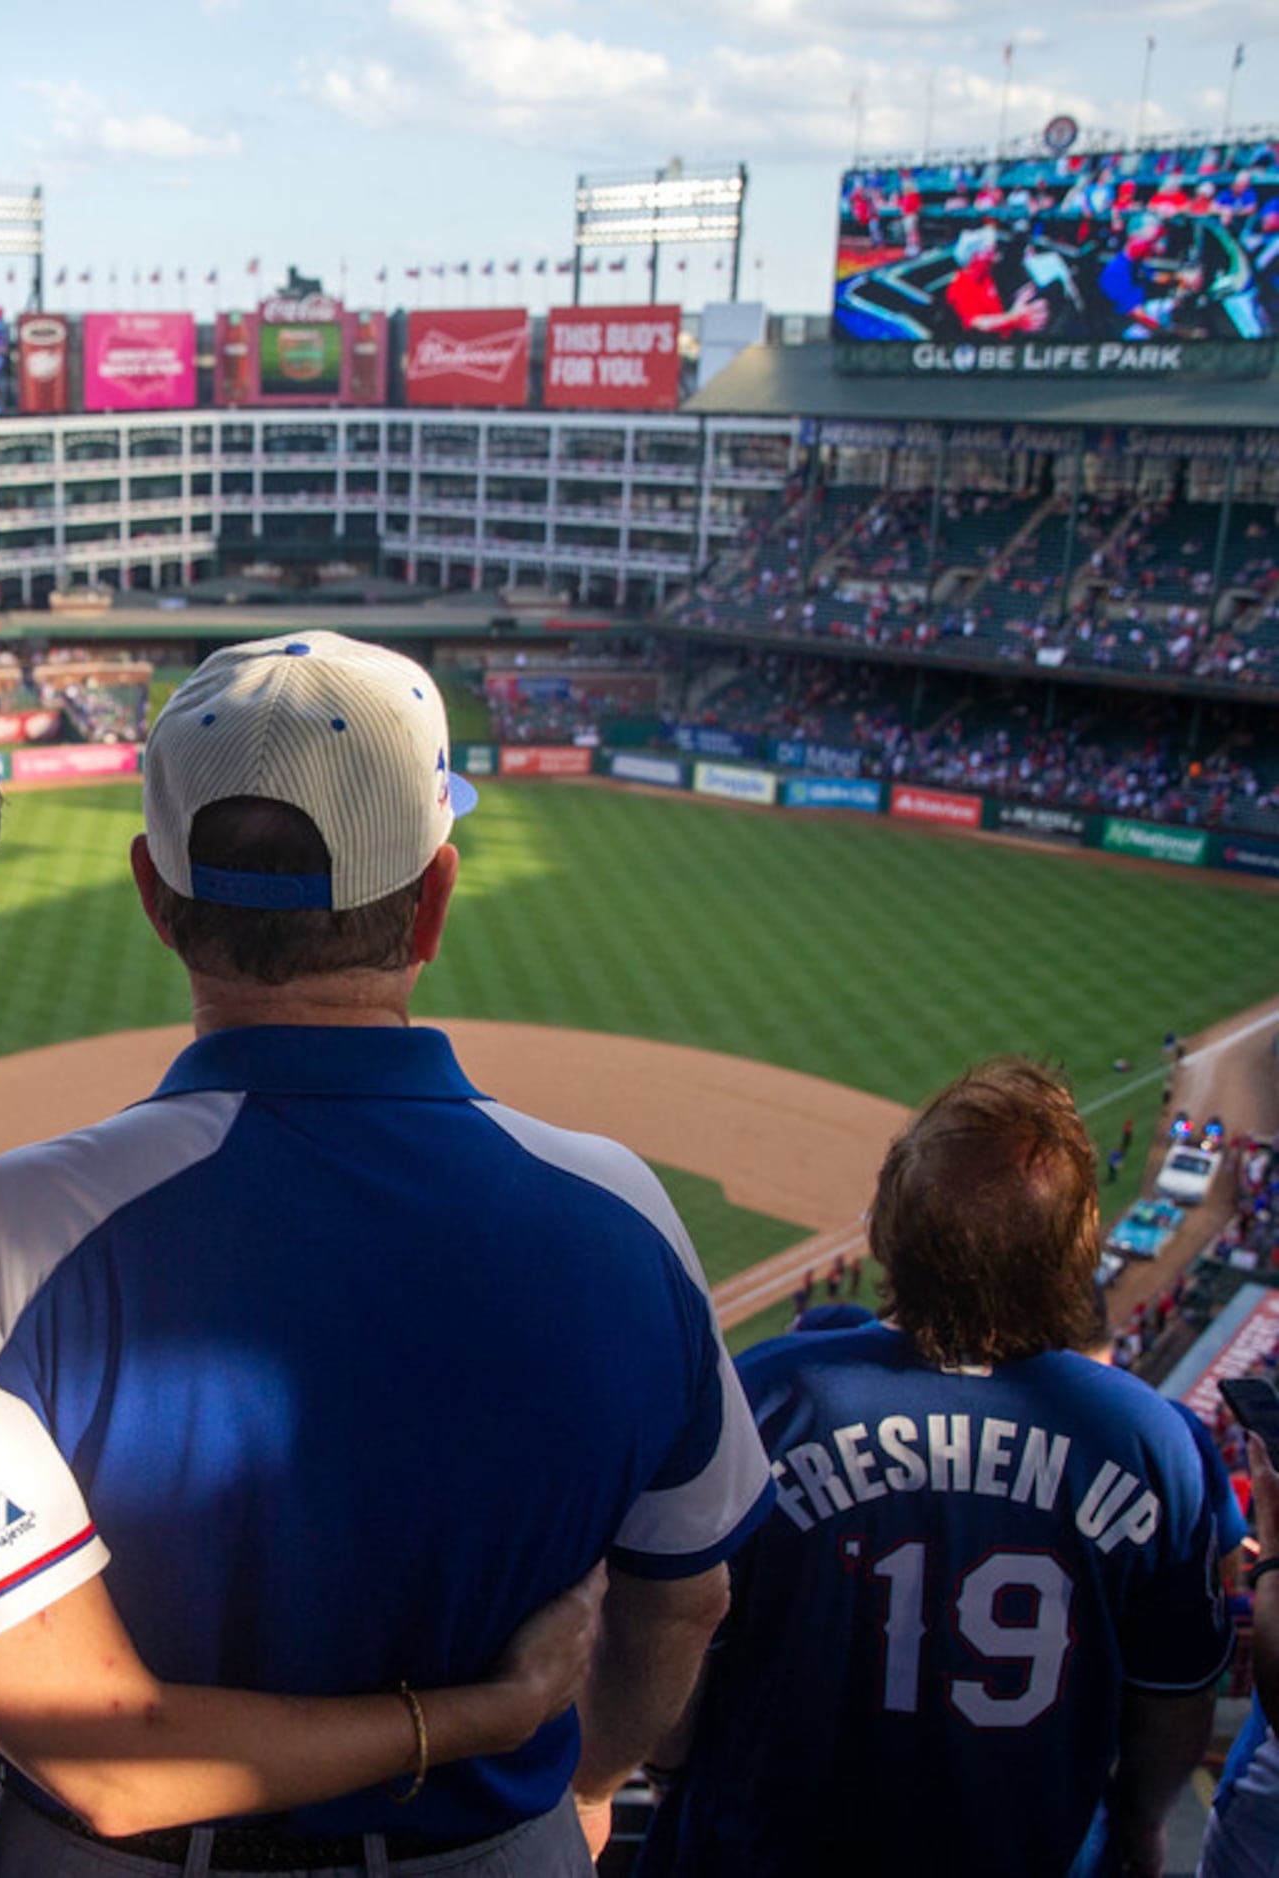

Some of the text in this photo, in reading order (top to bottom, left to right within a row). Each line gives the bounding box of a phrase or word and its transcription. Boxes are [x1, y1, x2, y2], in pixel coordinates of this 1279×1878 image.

[418, 338, 513, 366] Budweiser
[552, 322, 674, 352] THIS BUD'S
[549, 356, 651, 387] FOR YOU.
[912, 342, 1182, 371] GLOBE LIFE PARK
[770, 1414, 1162, 1554] FRESHEN UP
